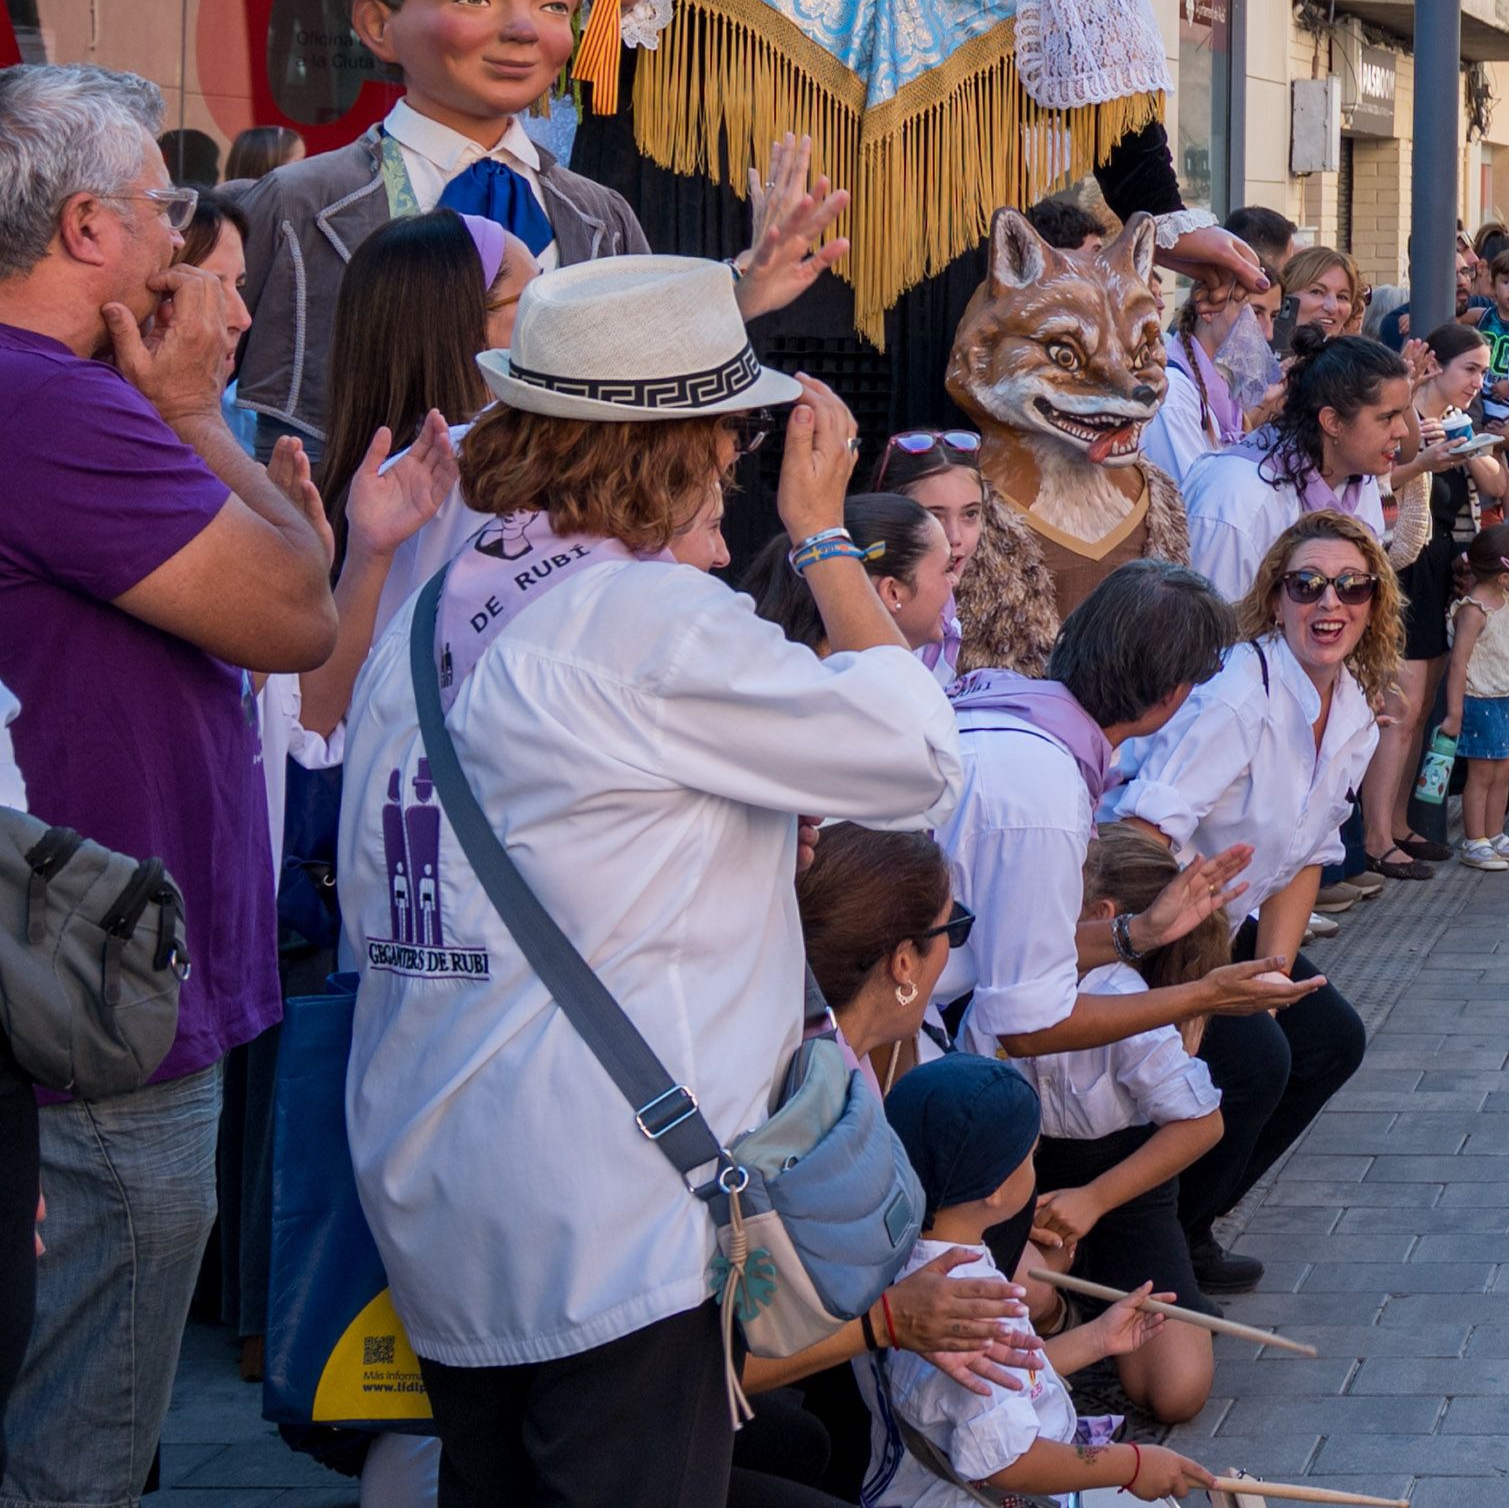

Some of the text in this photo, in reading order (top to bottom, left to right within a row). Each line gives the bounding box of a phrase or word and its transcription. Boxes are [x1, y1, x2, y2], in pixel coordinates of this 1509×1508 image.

[331, 53, 375, 69] Ciuta
[470, 595, 504, 634] DE
[368, 942, 425, 971] GEGANTERS
[426, 950, 450, 972] DE
[362, 1381, 427, 1394] www.lidlp
